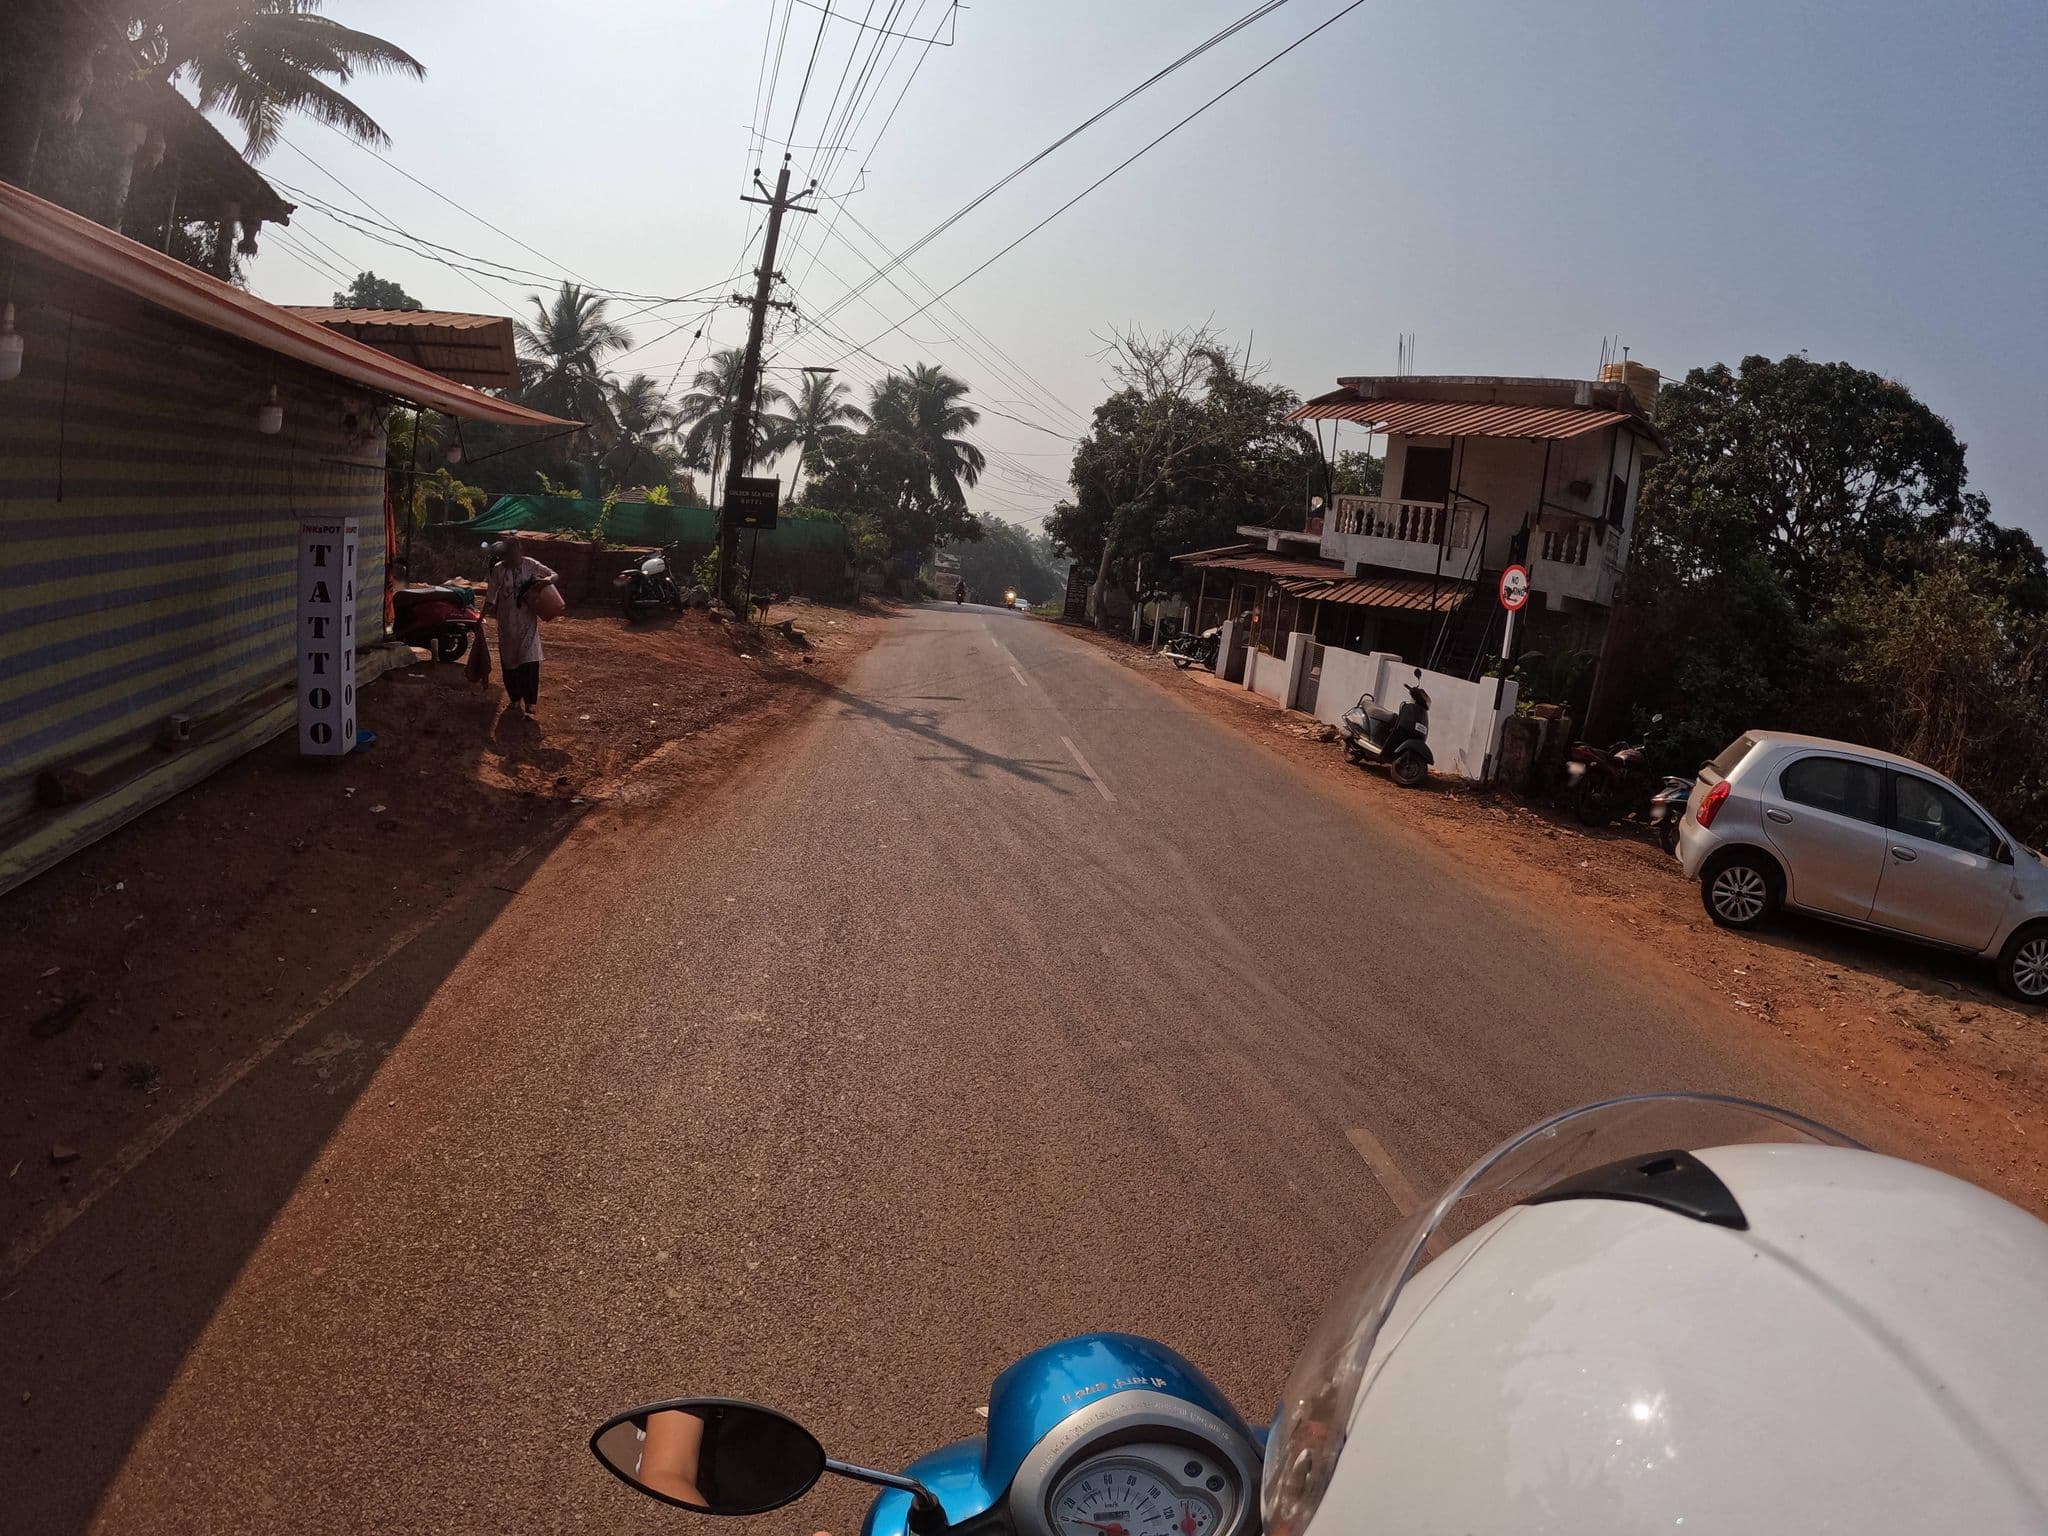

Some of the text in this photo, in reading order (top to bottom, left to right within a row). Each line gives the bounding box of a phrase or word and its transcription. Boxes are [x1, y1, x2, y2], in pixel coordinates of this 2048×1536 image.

[1512, 576, 1519, 585] NO
[308, 544, 333, 745] TATTOO
[344, 544, 355, 740] TATTOO
[1103, 1474, 1113, 1485] 60
[1126, 1475, 1138, 1487] 80
[1081, 1481, 1092, 1492] 40
[1146, 1484, 1161, 1500] 100
[1063, 1497, 1076, 1509] 20
[1162, 1506, 1176, 1520] 120
